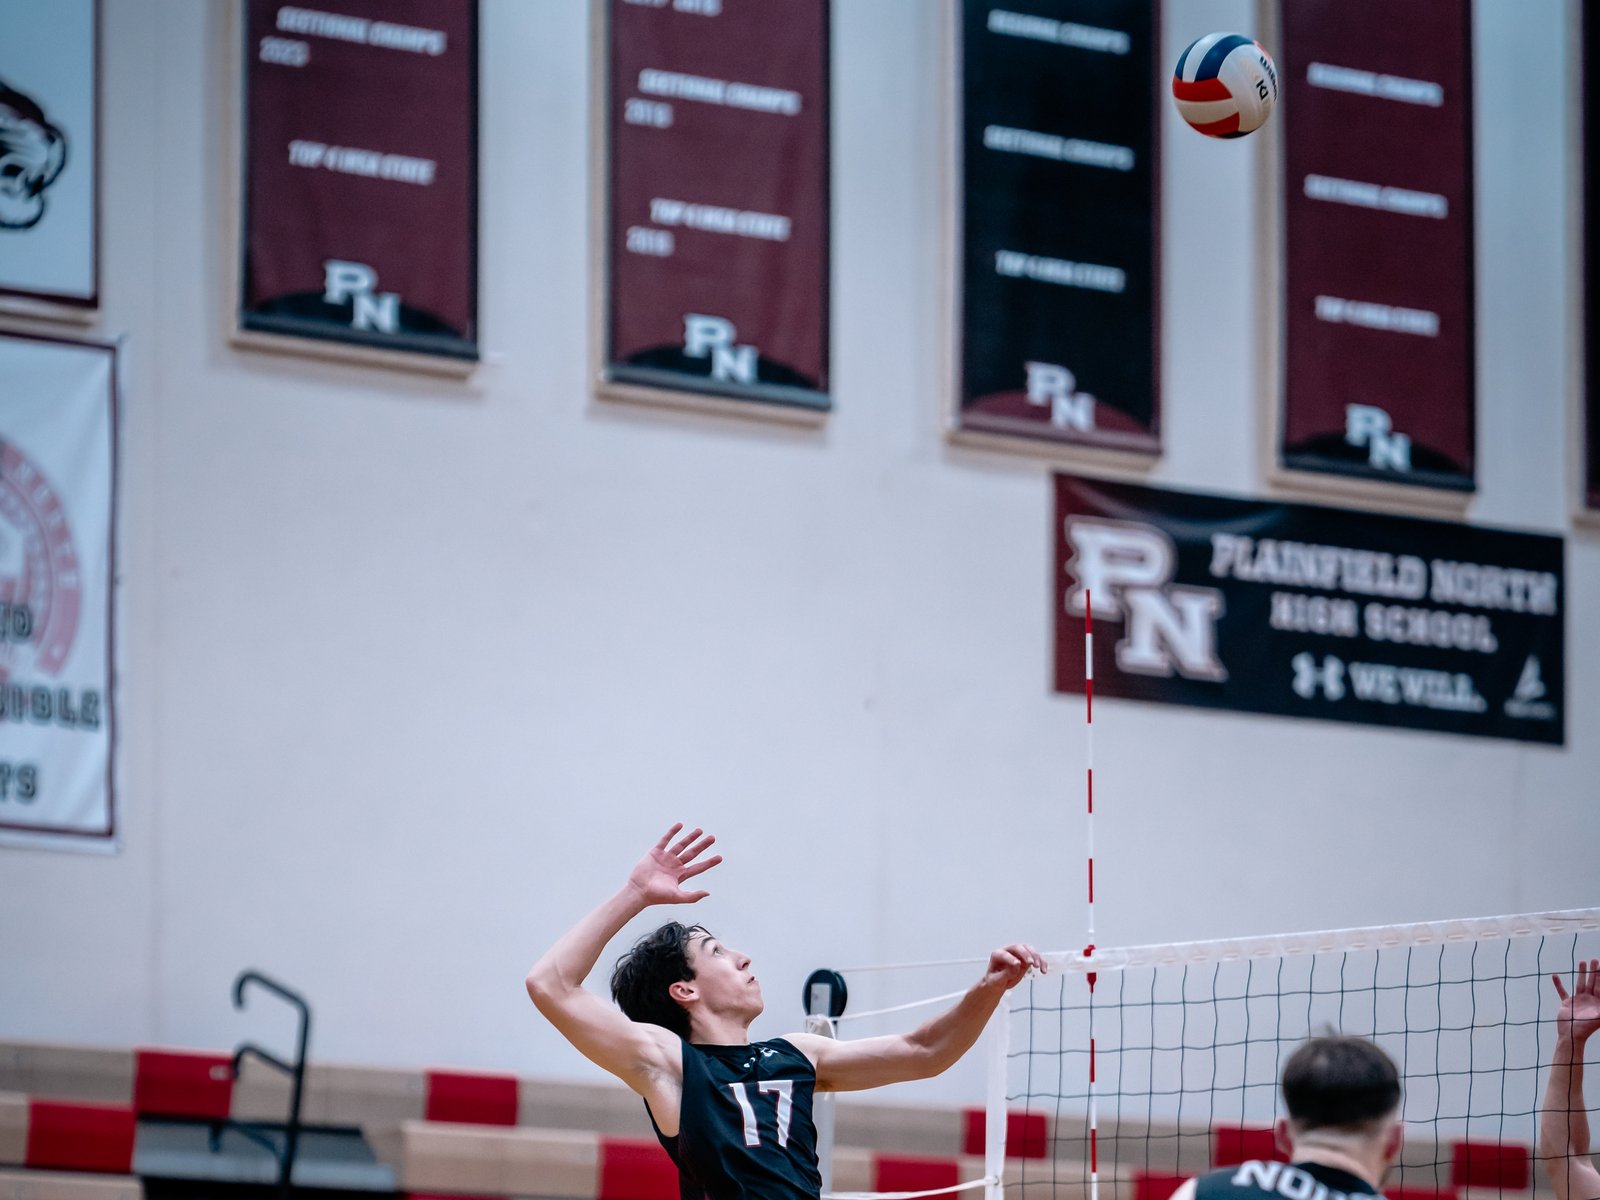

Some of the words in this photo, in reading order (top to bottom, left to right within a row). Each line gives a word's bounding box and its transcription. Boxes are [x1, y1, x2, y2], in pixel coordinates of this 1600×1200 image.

[1209, 532, 1428, 600] PLAINFIELD
[1430, 558, 1557, 616] NORTH
[1270, 590, 1358, 638] HIGH
[1364, 602, 1498, 654] SCHOOL
[728, 1079, 794, 1149] 17
